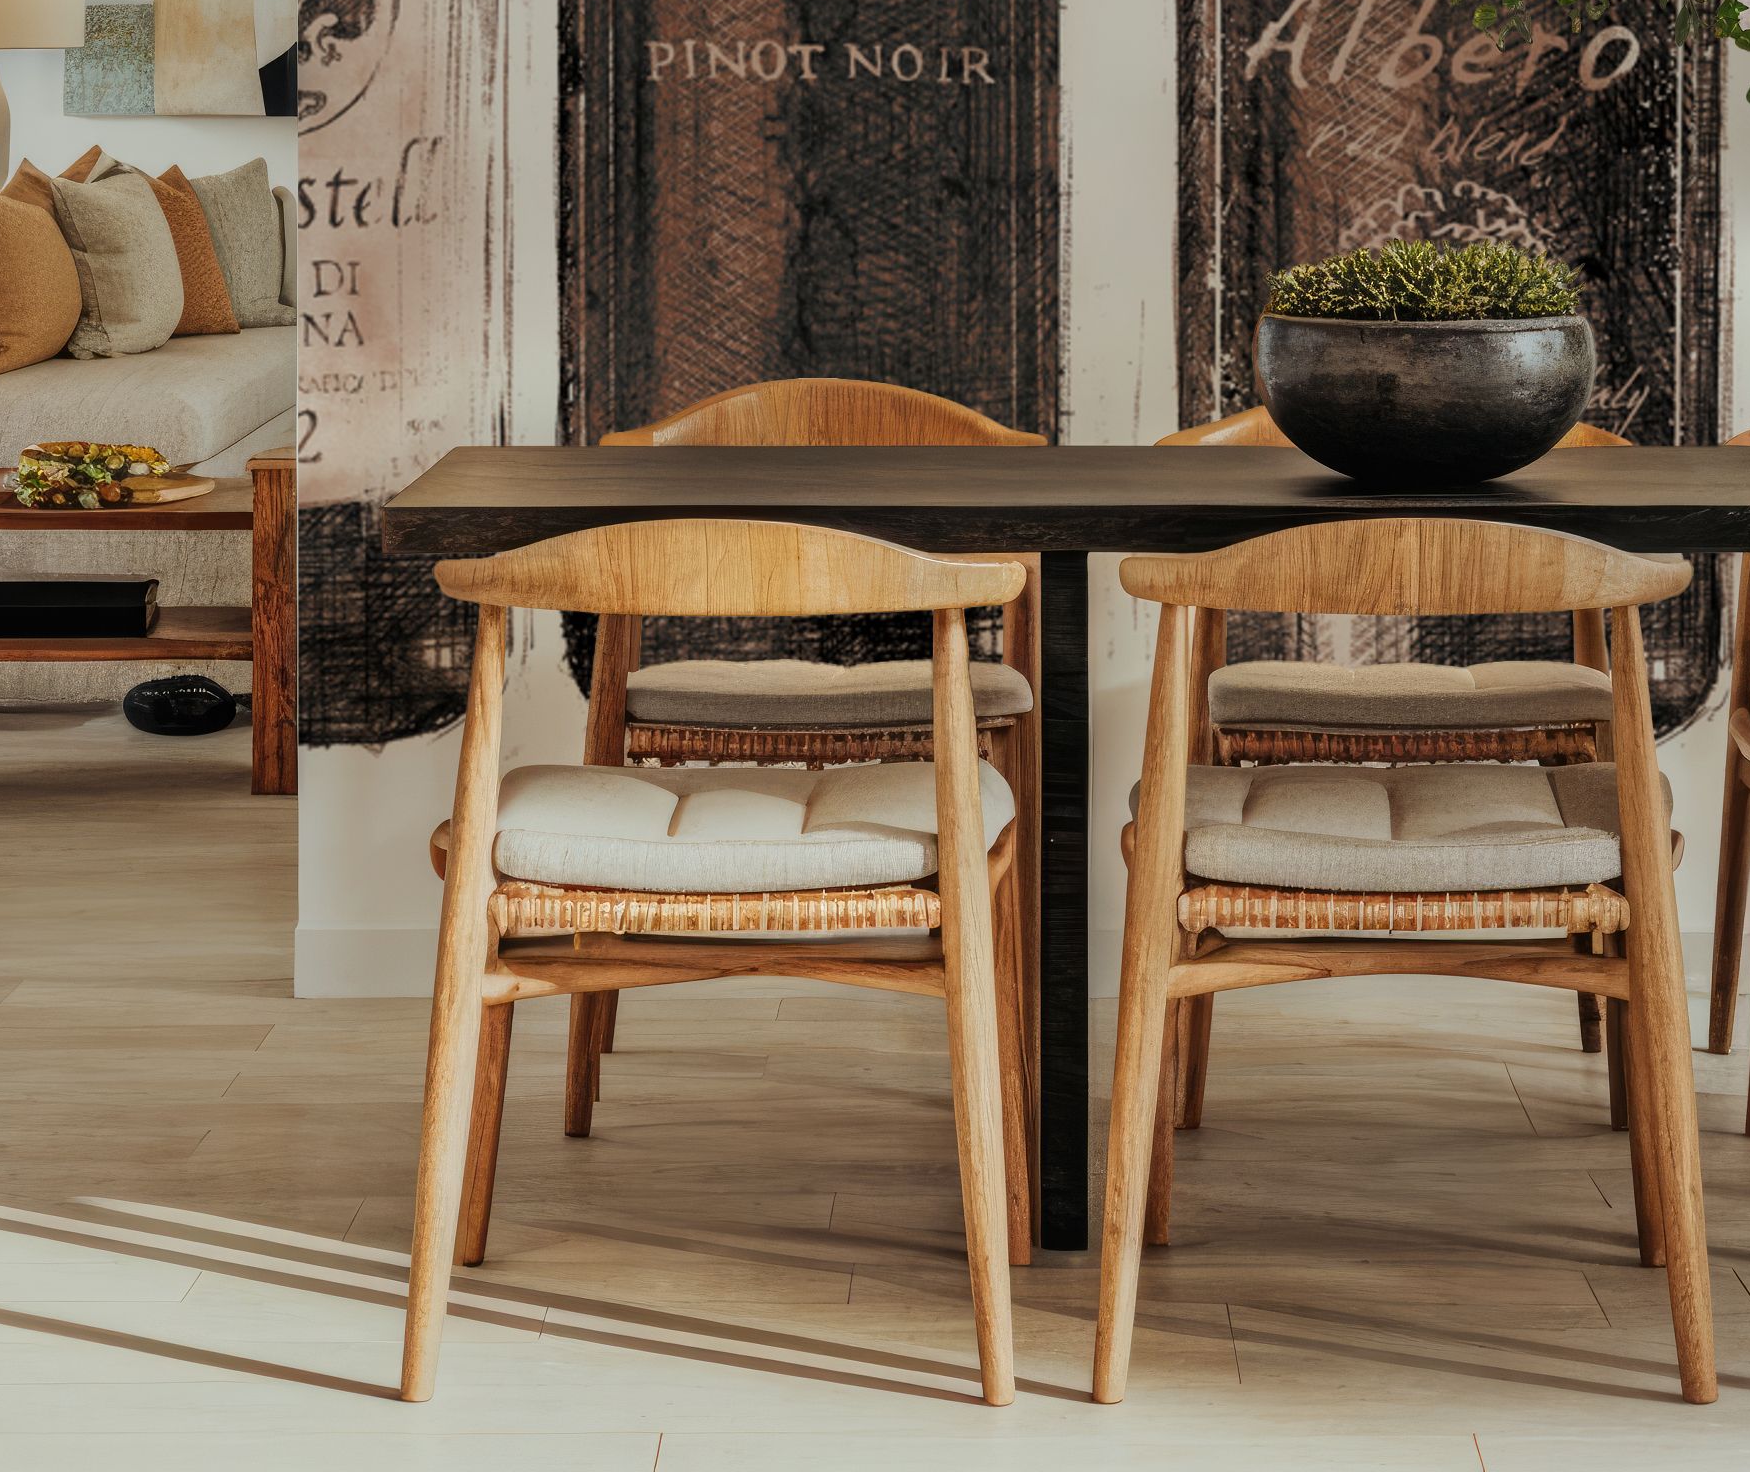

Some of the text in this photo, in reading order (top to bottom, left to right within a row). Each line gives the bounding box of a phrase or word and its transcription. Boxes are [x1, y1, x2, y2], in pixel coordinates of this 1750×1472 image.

[645, 39, 996, 85] PINOT NOIR
[312, 259, 361, 298] DI
